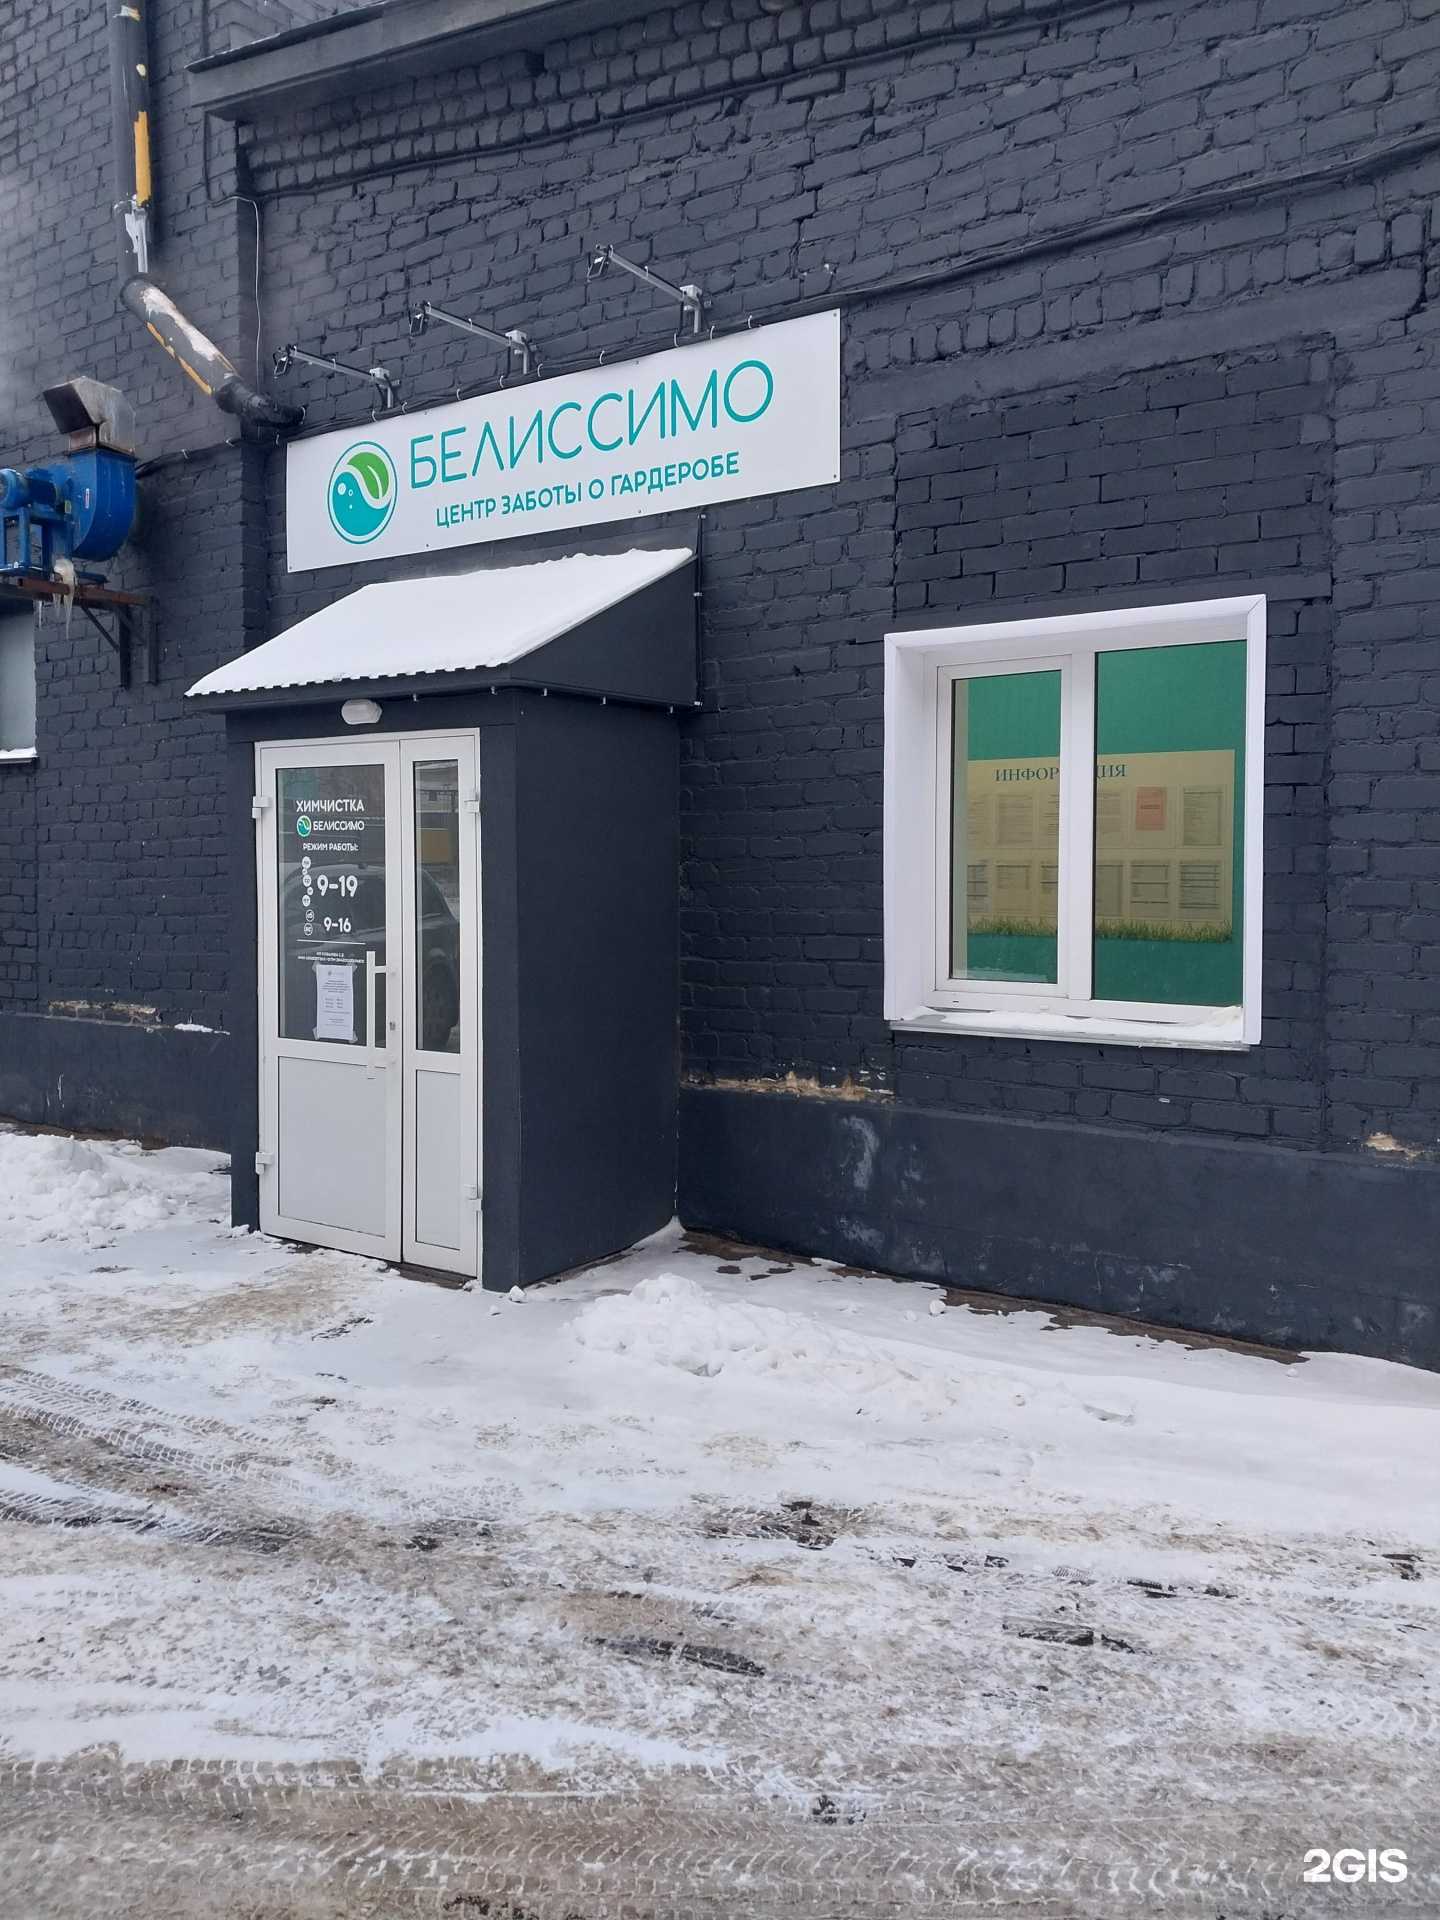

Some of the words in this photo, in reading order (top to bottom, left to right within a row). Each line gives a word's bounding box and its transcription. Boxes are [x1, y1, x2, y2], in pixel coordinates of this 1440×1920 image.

[410, 359, 774, 489] БЕЛИССИМО
[436, 498, 497, 528] ЦЕНТР
[501, 482, 582, 515] ЗАБОТЫ
[588, 478, 604, 499] О
[611, 451, 739, 497] ГАРДЕРОБЕ
[994, 764, 1127, 781] ИНФОРИЯ
[296, 799, 364, 812] ХИМЧИСТКА
[313, 820, 365, 831] БЕЛИССИМО
[303, 842, 328, 851] РЕЖИМ
[317, 874, 358, 897] 9-19
[324, 917, 351, 933] 9-16
